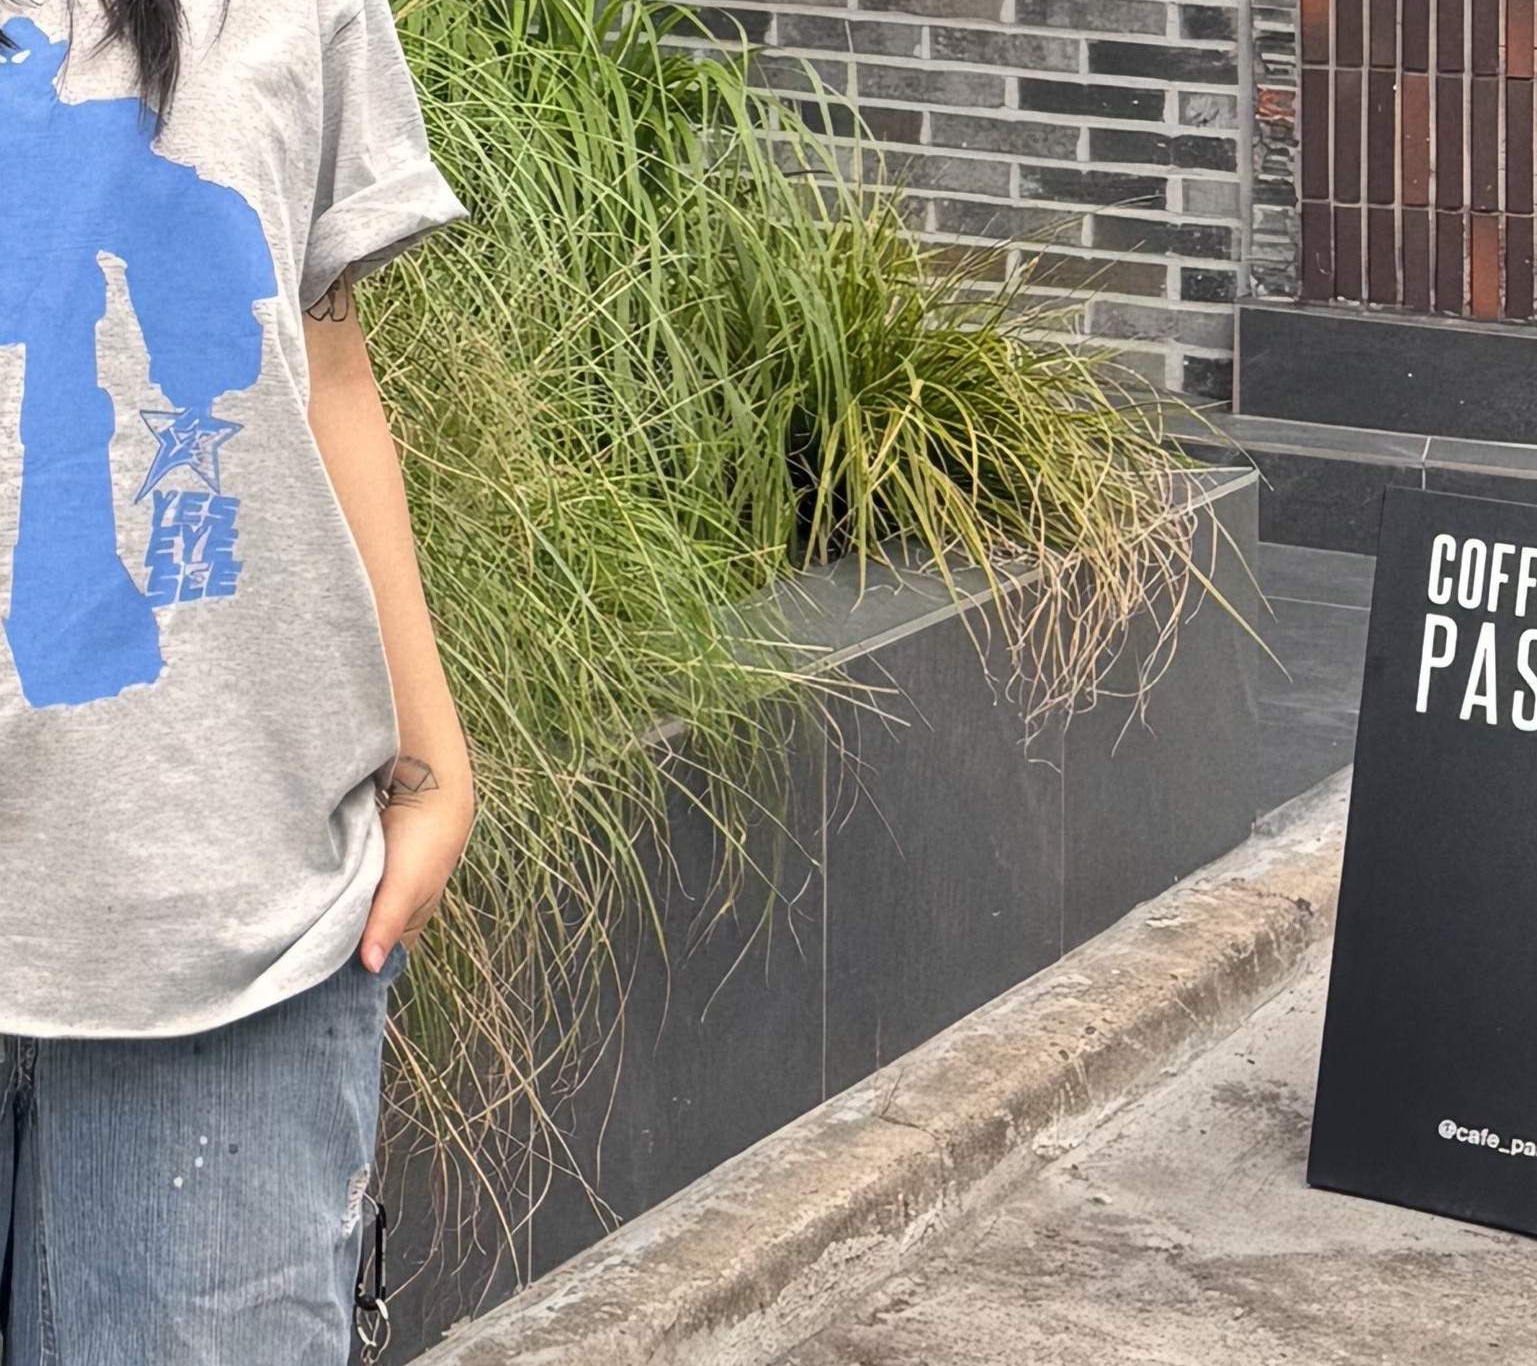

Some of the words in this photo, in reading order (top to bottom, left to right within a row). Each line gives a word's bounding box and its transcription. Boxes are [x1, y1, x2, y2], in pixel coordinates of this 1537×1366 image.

[152, 489, 241, 529] YES
[145, 523, 239, 567] EYE
[145, 560, 244, 609] SEE
[1427, 533, 1537, 617] COFF
[1415, 613, 1537, 732] PAS
[1438, 1119, 1537, 1157] @cafe_pa
